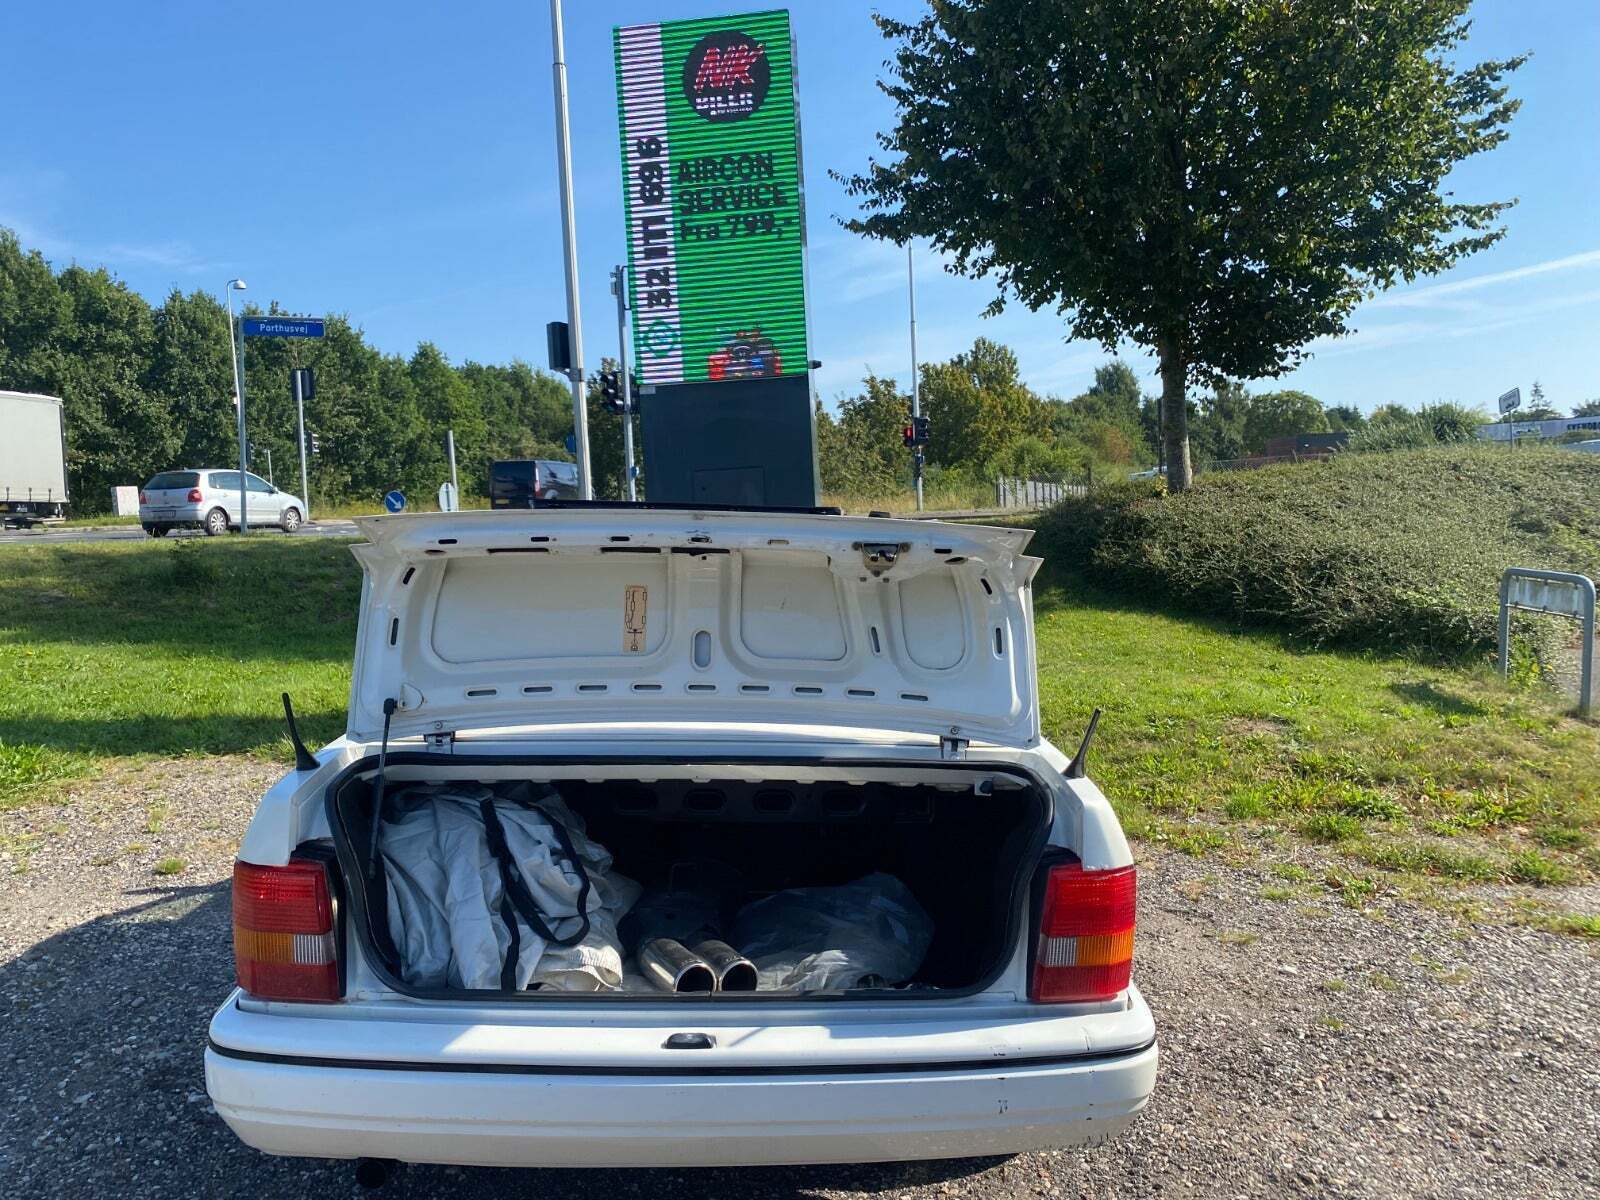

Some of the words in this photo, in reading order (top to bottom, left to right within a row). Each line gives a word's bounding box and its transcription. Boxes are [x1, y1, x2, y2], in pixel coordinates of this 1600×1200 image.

[679, 152, 772, 182] AIRCON
[679, 184, 786, 215] SERVICE
[647, 267, 672, 308] 32
[259, 323, 308, 334] Porthusvej
